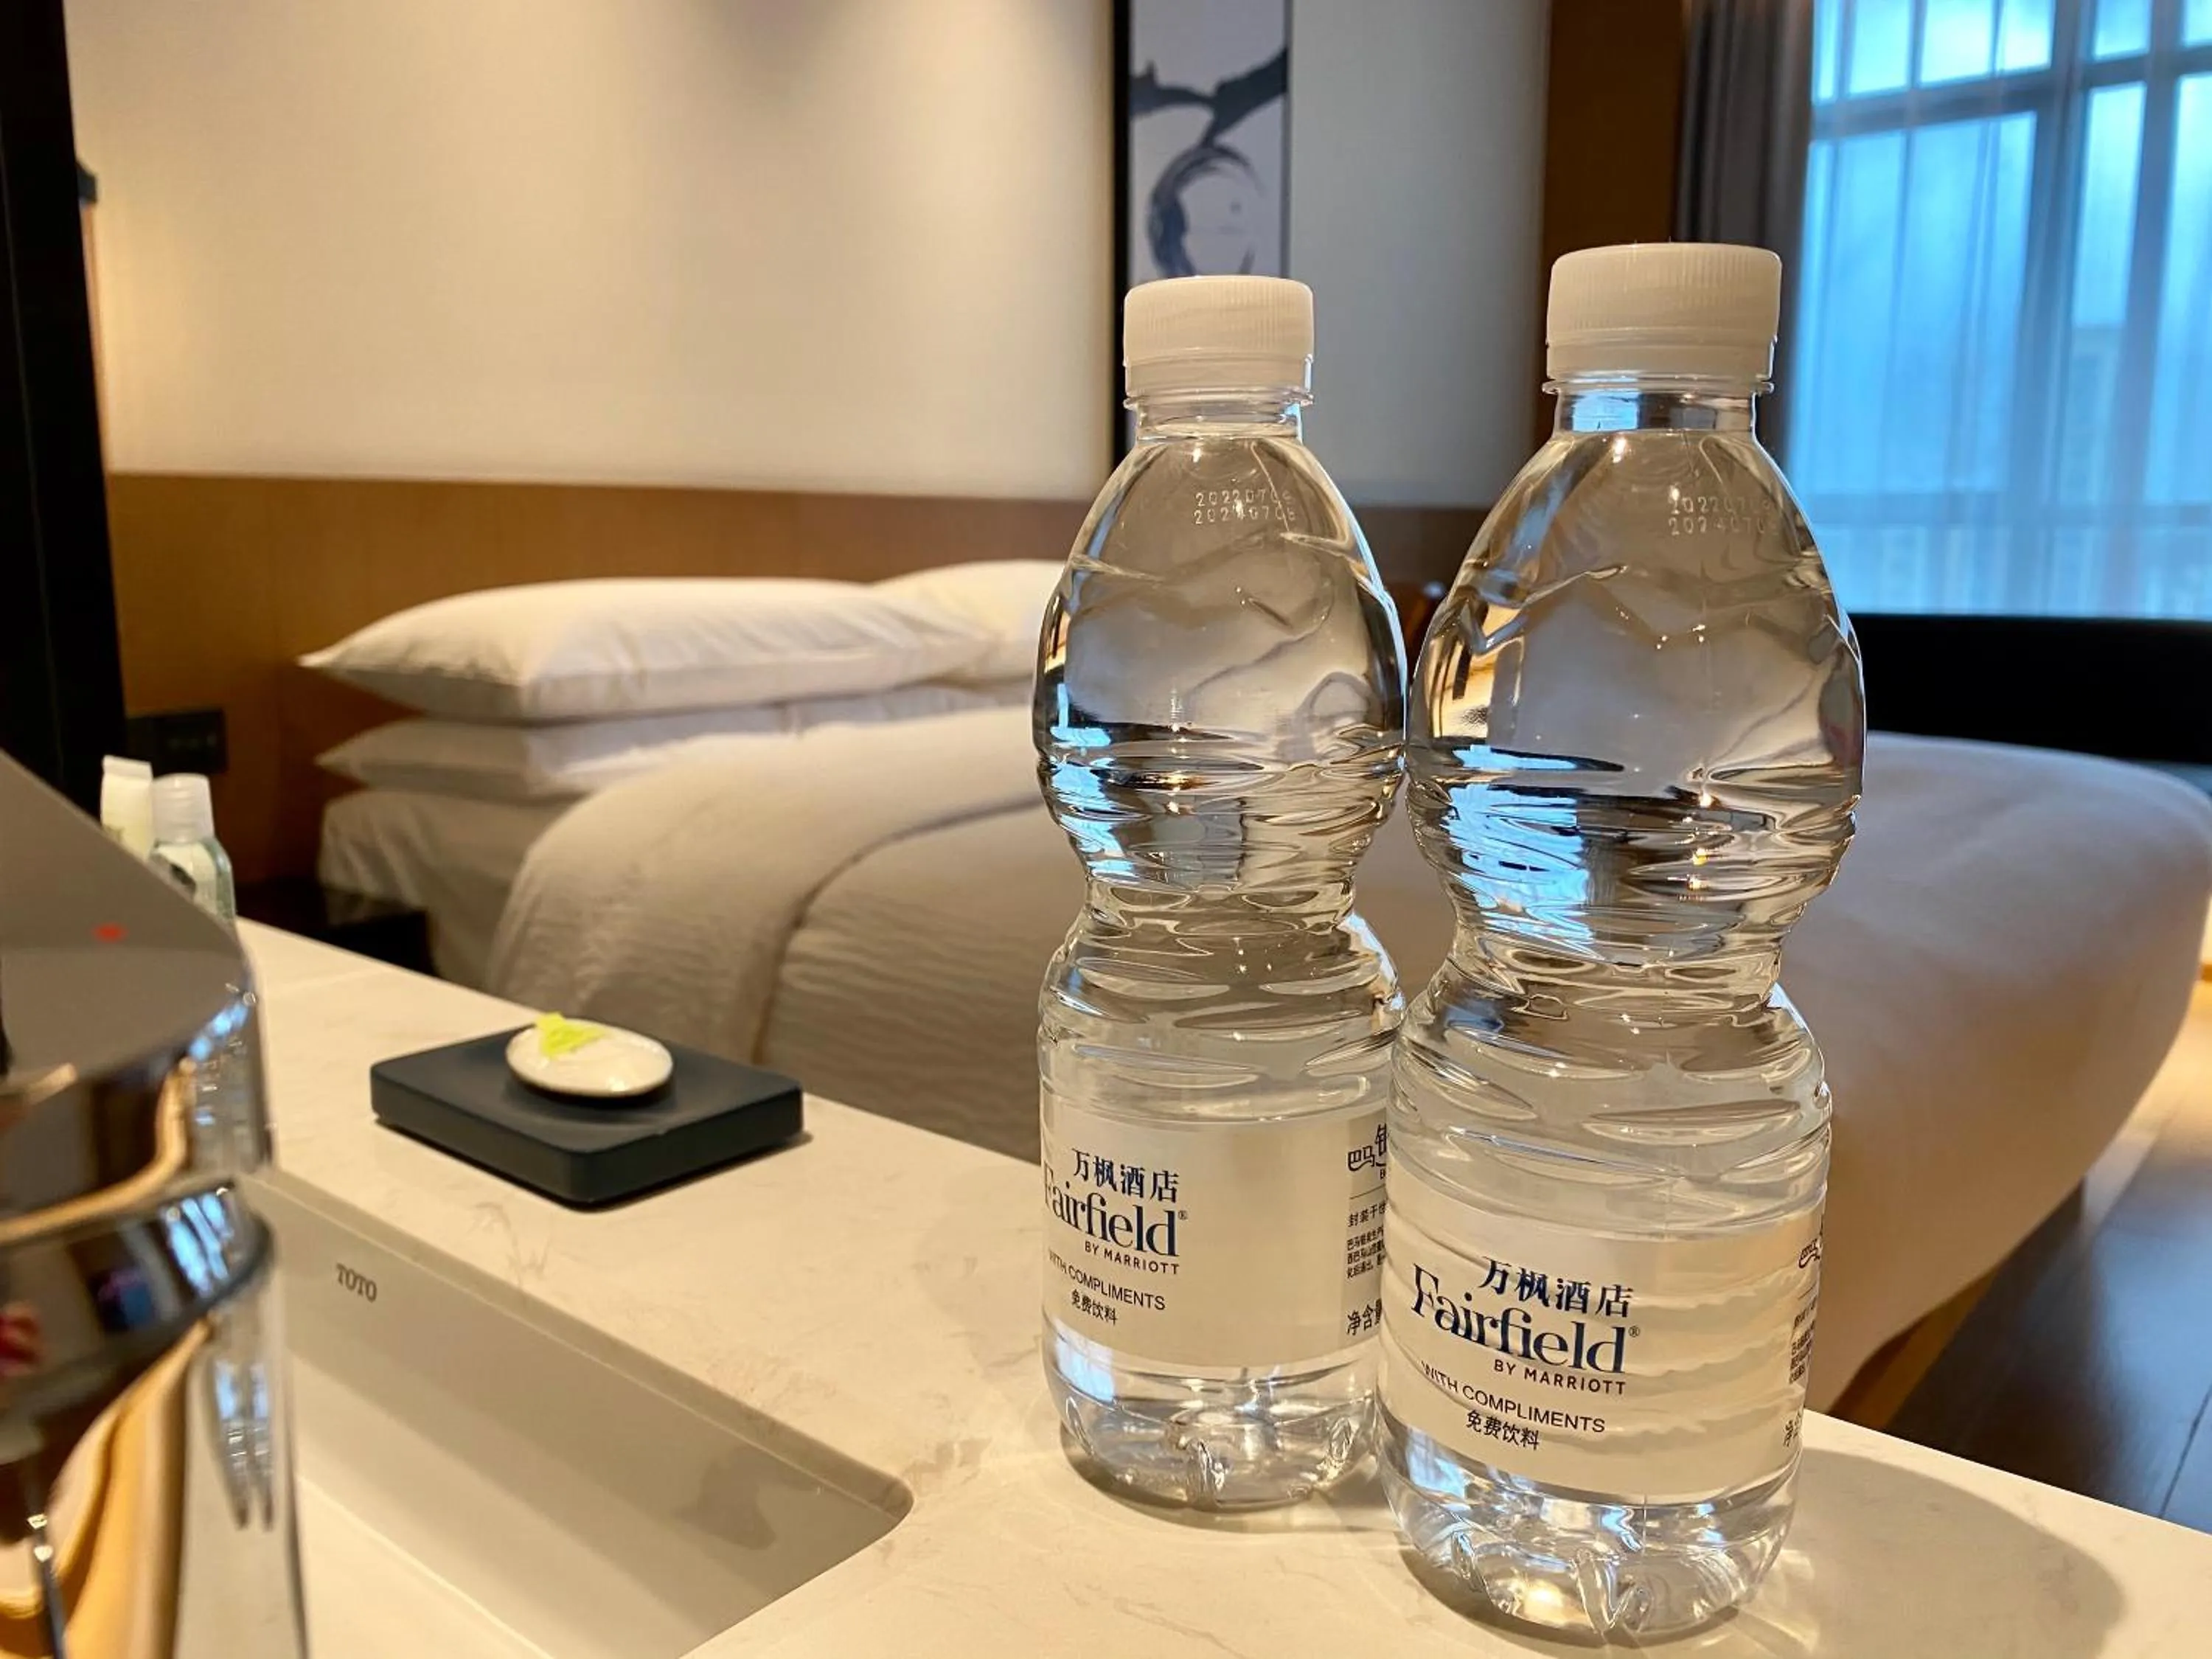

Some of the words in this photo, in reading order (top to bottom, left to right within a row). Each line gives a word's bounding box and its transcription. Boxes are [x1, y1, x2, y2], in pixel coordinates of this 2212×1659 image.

[1071, 1147, 1180, 1203] 万枫酒店
[1043, 1160, 1180, 1258] Fairfield
[1085, 1240, 1100, 1255] BY
[1104, 1248, 1180, 1275] MARRIOTT
[336, 1262, 378, 1304] TOTO
[1068, 1264, 1166, 1311] COMPLIMENTS
[1478, 1255, 1634, 1318] 万枫酒店
[1071, 1288, 1118, 1326] 免费饮料
[1411, 1262, 1626, 1374] Fairfield
[1493, 1359, 1517, 1376] BY
[1524, 1368, 1627, 1395] MARRIOTT
[1462, 1385, 1606, 1433] COMPLIMENTS
[1466, 1409, 1540, 1451] 免费饮料
